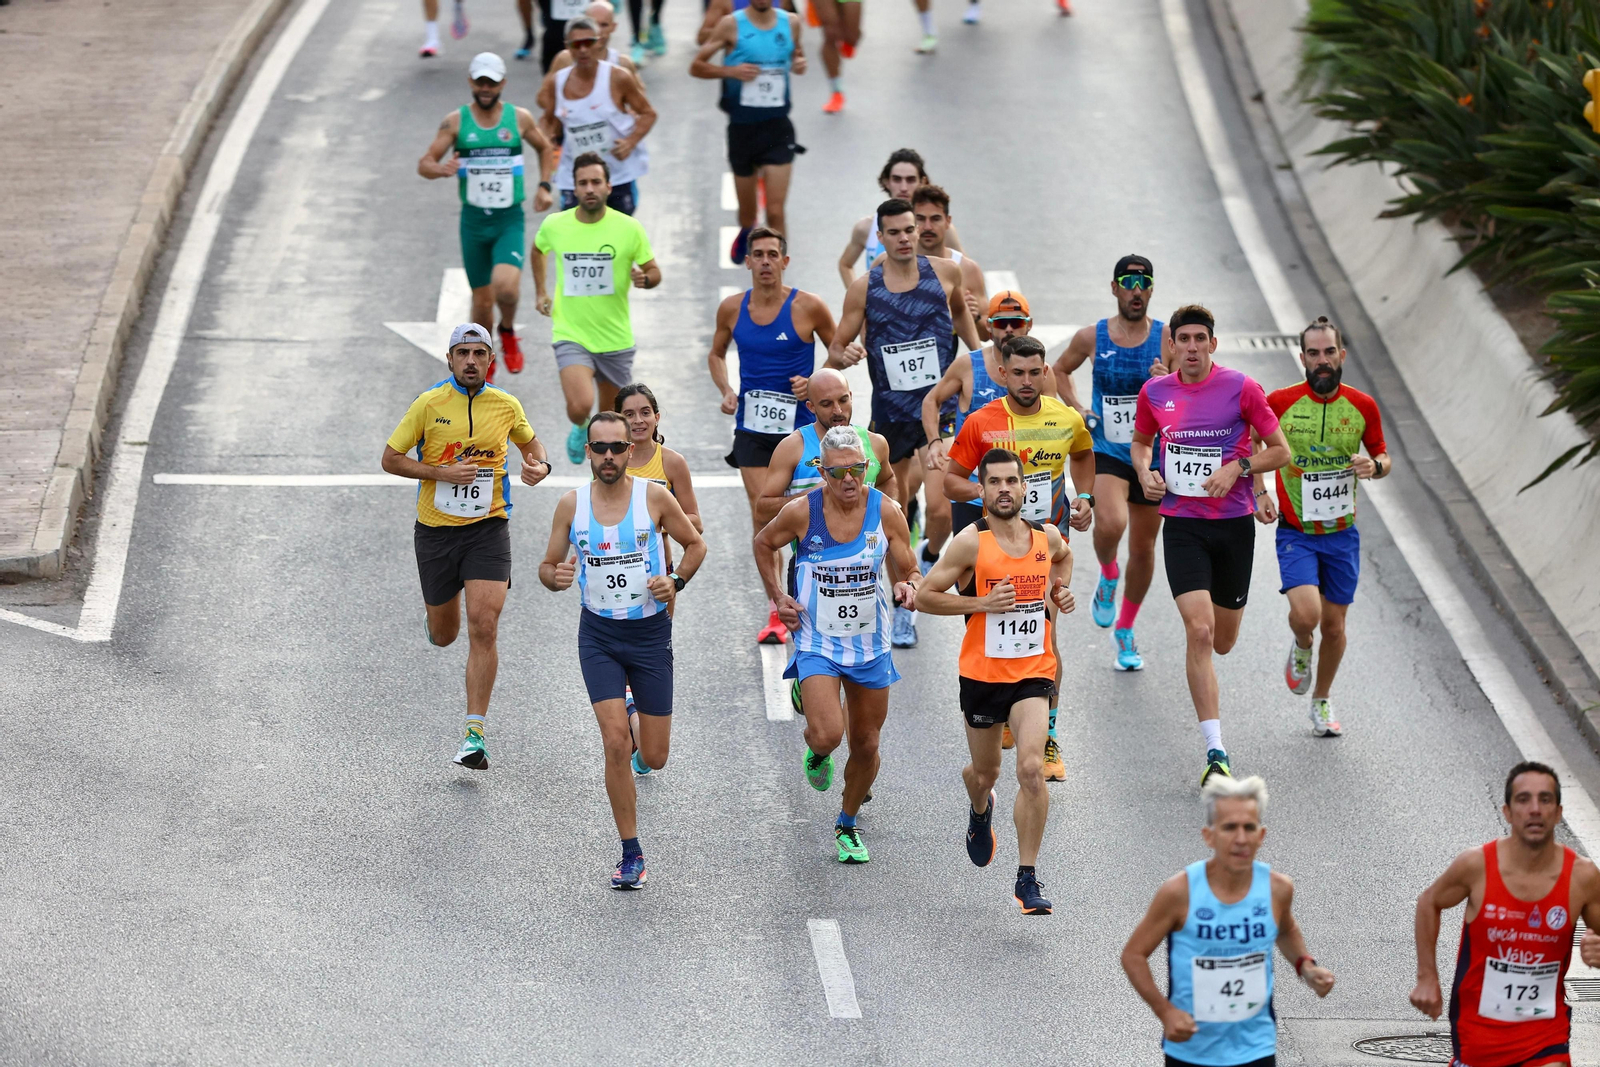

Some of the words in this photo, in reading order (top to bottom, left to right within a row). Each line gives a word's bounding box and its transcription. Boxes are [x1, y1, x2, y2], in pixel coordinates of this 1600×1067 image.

[480, 182, 502, 192] 142
[572, 266, 604, 278] 6707
[883, 346, 898, 354] 43
[899, 357, 925, 373] 187
[1105, 397, 1119, 405] 43
[754, 404, 787, 421] 1366
[1169, 428, 1232, 439] TRITRAIN4YOU
[1033, 448, 1062, 461] Álora
[1168, 444, 1180, 455] 43
[1312, 455, 1352, 466] HYUNDA
[1175, 461, 1212, 476] 1475
[1304, 474, 1319, 482] 43
[452, 485, 480, 499] 116
[1313, 484, 1348, 500] 6444
[588, 557, 601, 567] 43
[808, 553, 823, 561] vive
[606, 574, 627, 589] 36
[812, 572, 876, 584] MÁLAGA
[1014, 575, 1040, 583] TEAM
[820, 587, 835, 597] 43
[838, 605, 858, 618] 83
[998, 619, 1037, 635] 1140
[1196, 917, 1266, 944] nerja
[1489, 960, 1508, 973] 43
[1220, 979, 1244, 997] 42
[1504, 984, 1539, 1001] 173
